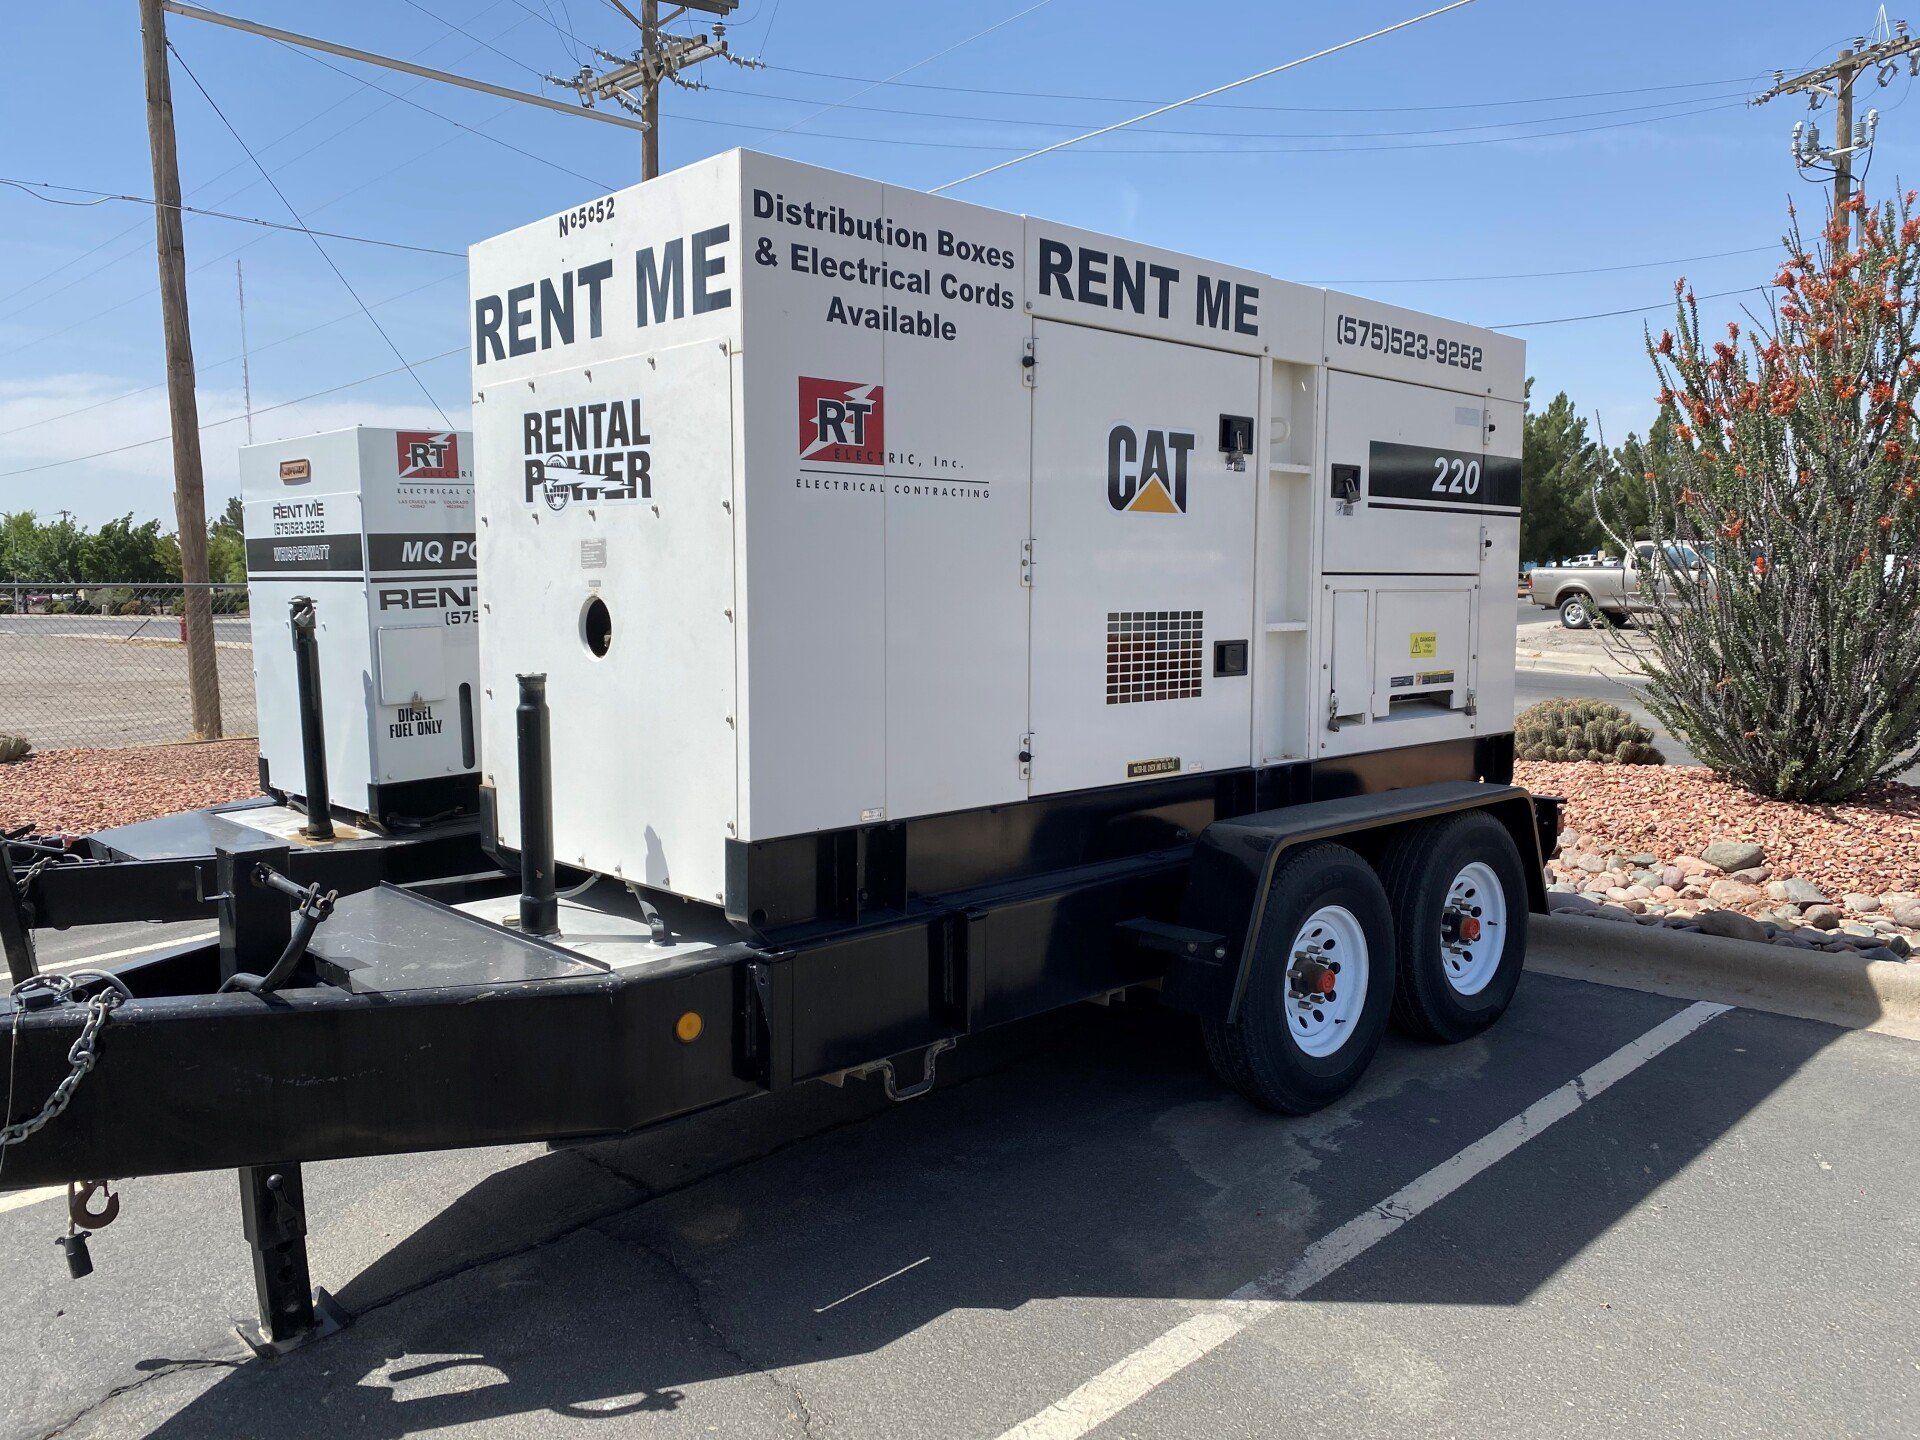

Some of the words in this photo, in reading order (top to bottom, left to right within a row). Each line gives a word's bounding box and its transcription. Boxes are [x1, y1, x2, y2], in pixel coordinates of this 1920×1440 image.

[753, 188, 927, 252] Distribution
[937, 229, 1015, 270] Boxes
[754, 236, 779, 267] &
[790, 243, 930, 295] Electrical
[940, 273, 1014, 310] Cords
[1039, 237, 1180, 319] RENT
[1196, 274, 1260, 337] ME
[475, 259, 613, 366] RENT
[636, 223, 732, 328] ME
[826, 295, 957, 341] Available
[1337, 314, 1483, 372] (575)523-9252
[524, 398, 651, 455] RENTAL
[818, 399, 872, 445] RT
[410, 443, 448, 468] RT
[933, 456, 965, 469] Inc.
[1107, 425, 1195, 514] CAT
[1431, 456, 1481, 495] 220
[796, 478, 885, 493] ELECTRICAL
[894, 484, 990, 499] CONTRACTING
[273, 504, 303, 519] RENT
[305, 502, 325, 517] ME
[402, 540, 444, 564] MQ
[379, 586, 478, 611] REN
[389, 722, 414, 739] FUEL
[417, 720, 443, 736] ONLY
[398, 706, 433, 722] DIESEL
